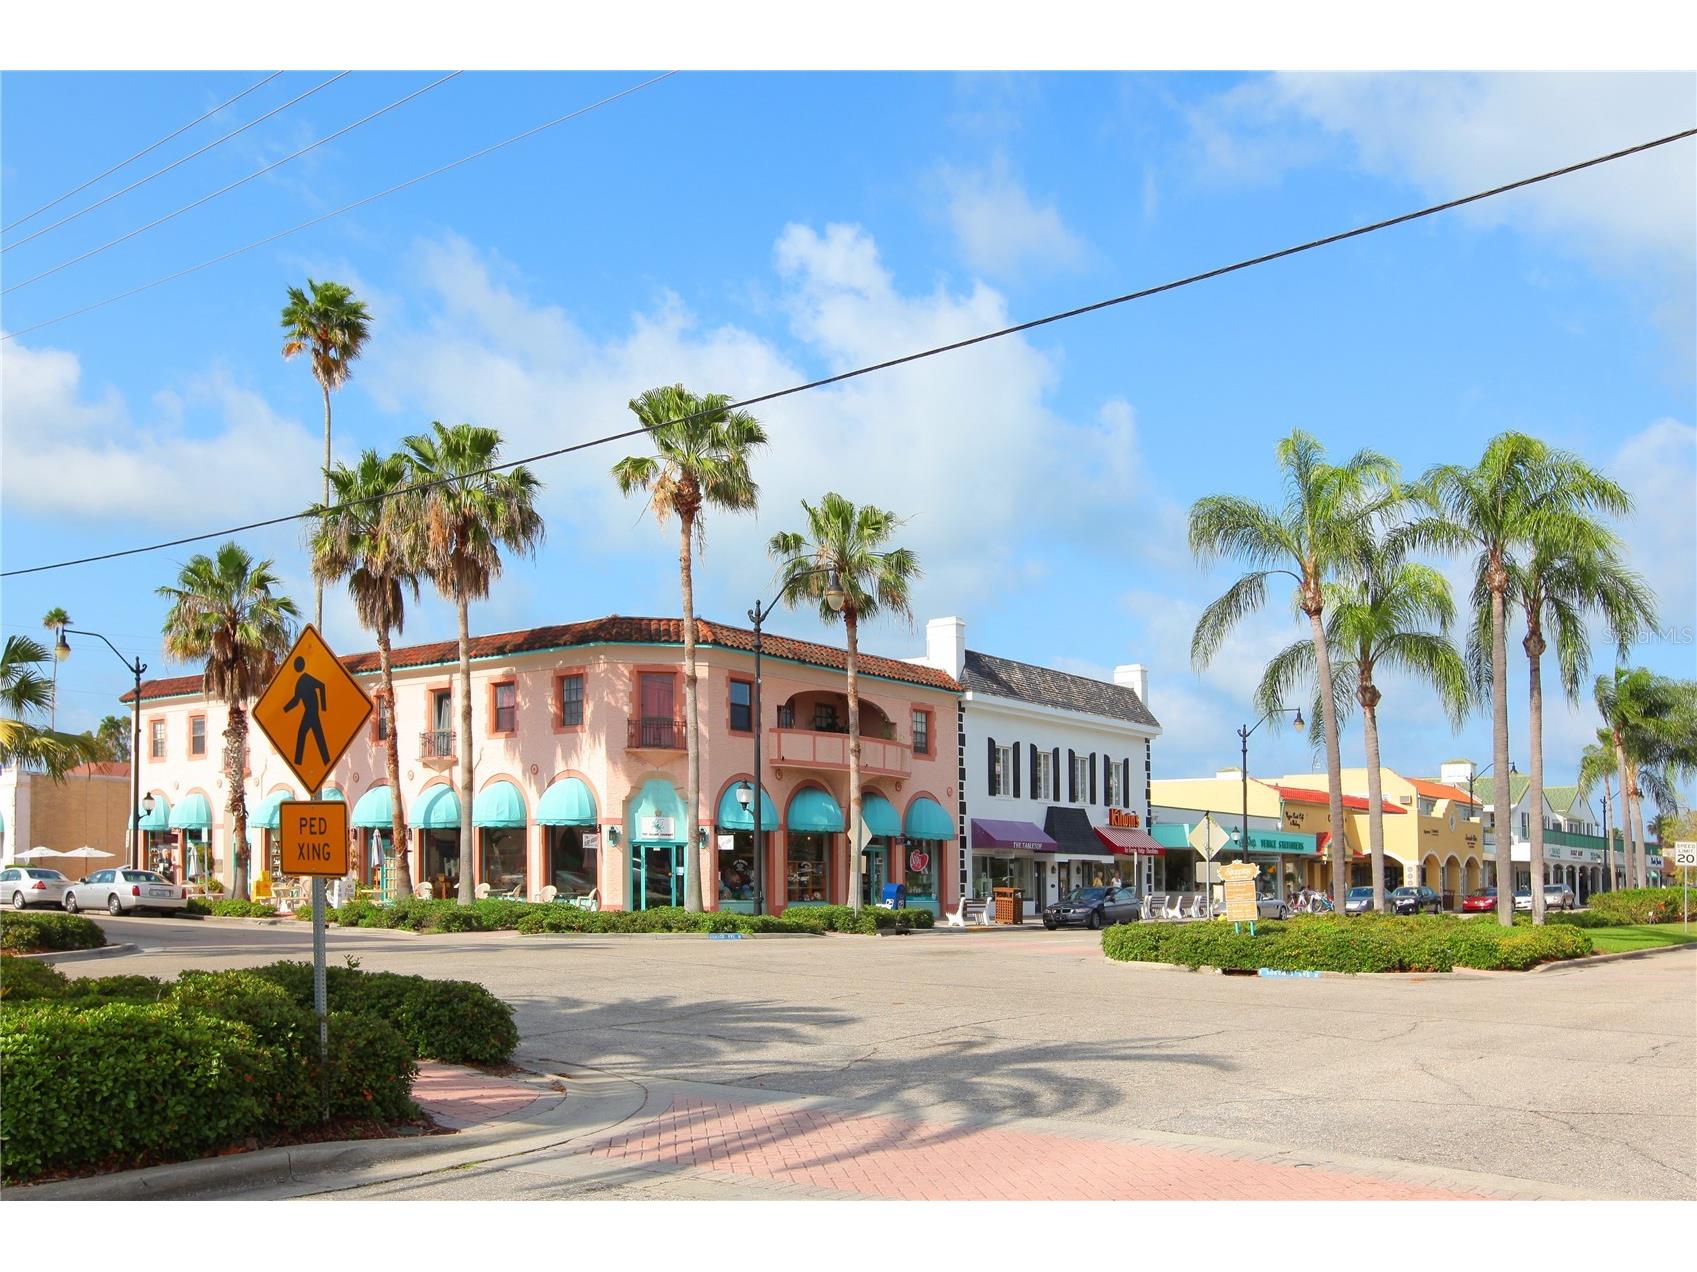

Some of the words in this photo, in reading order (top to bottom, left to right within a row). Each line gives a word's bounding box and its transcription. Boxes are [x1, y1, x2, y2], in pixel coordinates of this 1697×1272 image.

[299, 817, 328, 835] PED
[1110, 808, 1140, 827] Kilwin's
[297, 843, 331, 861] XING
[1677, 853, 1695, 864] 20
